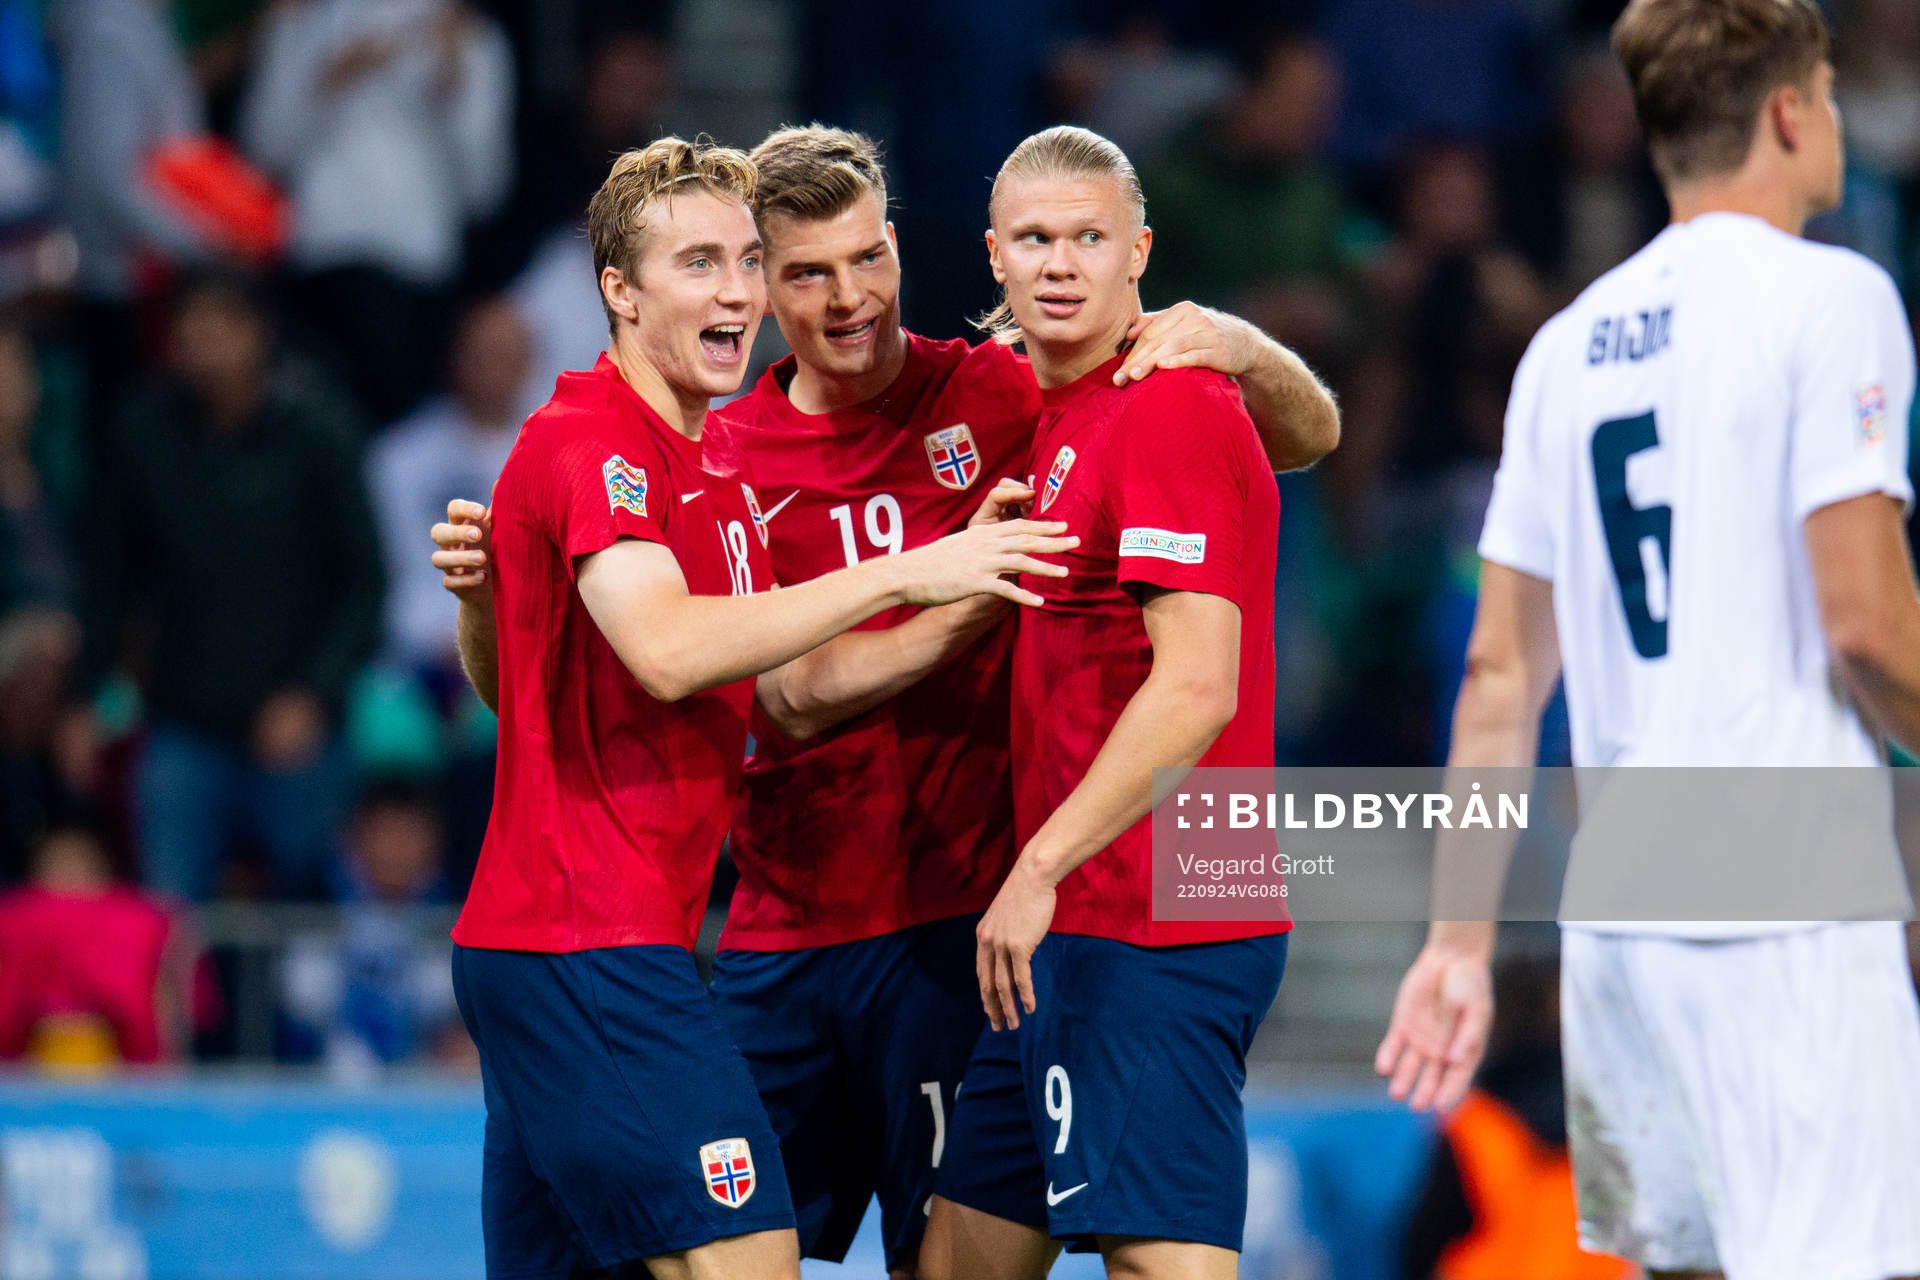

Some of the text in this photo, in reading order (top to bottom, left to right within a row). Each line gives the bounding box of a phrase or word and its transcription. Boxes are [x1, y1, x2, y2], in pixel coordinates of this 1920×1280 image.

[717, 520, 753, 597] 18
[829, 493, 904, 569] 19
[1122, 536, 1202, 553] FOUNDATION
[1591, 408, 1672, 659] 6
[1045, 1064, 1073, 1155] 9
